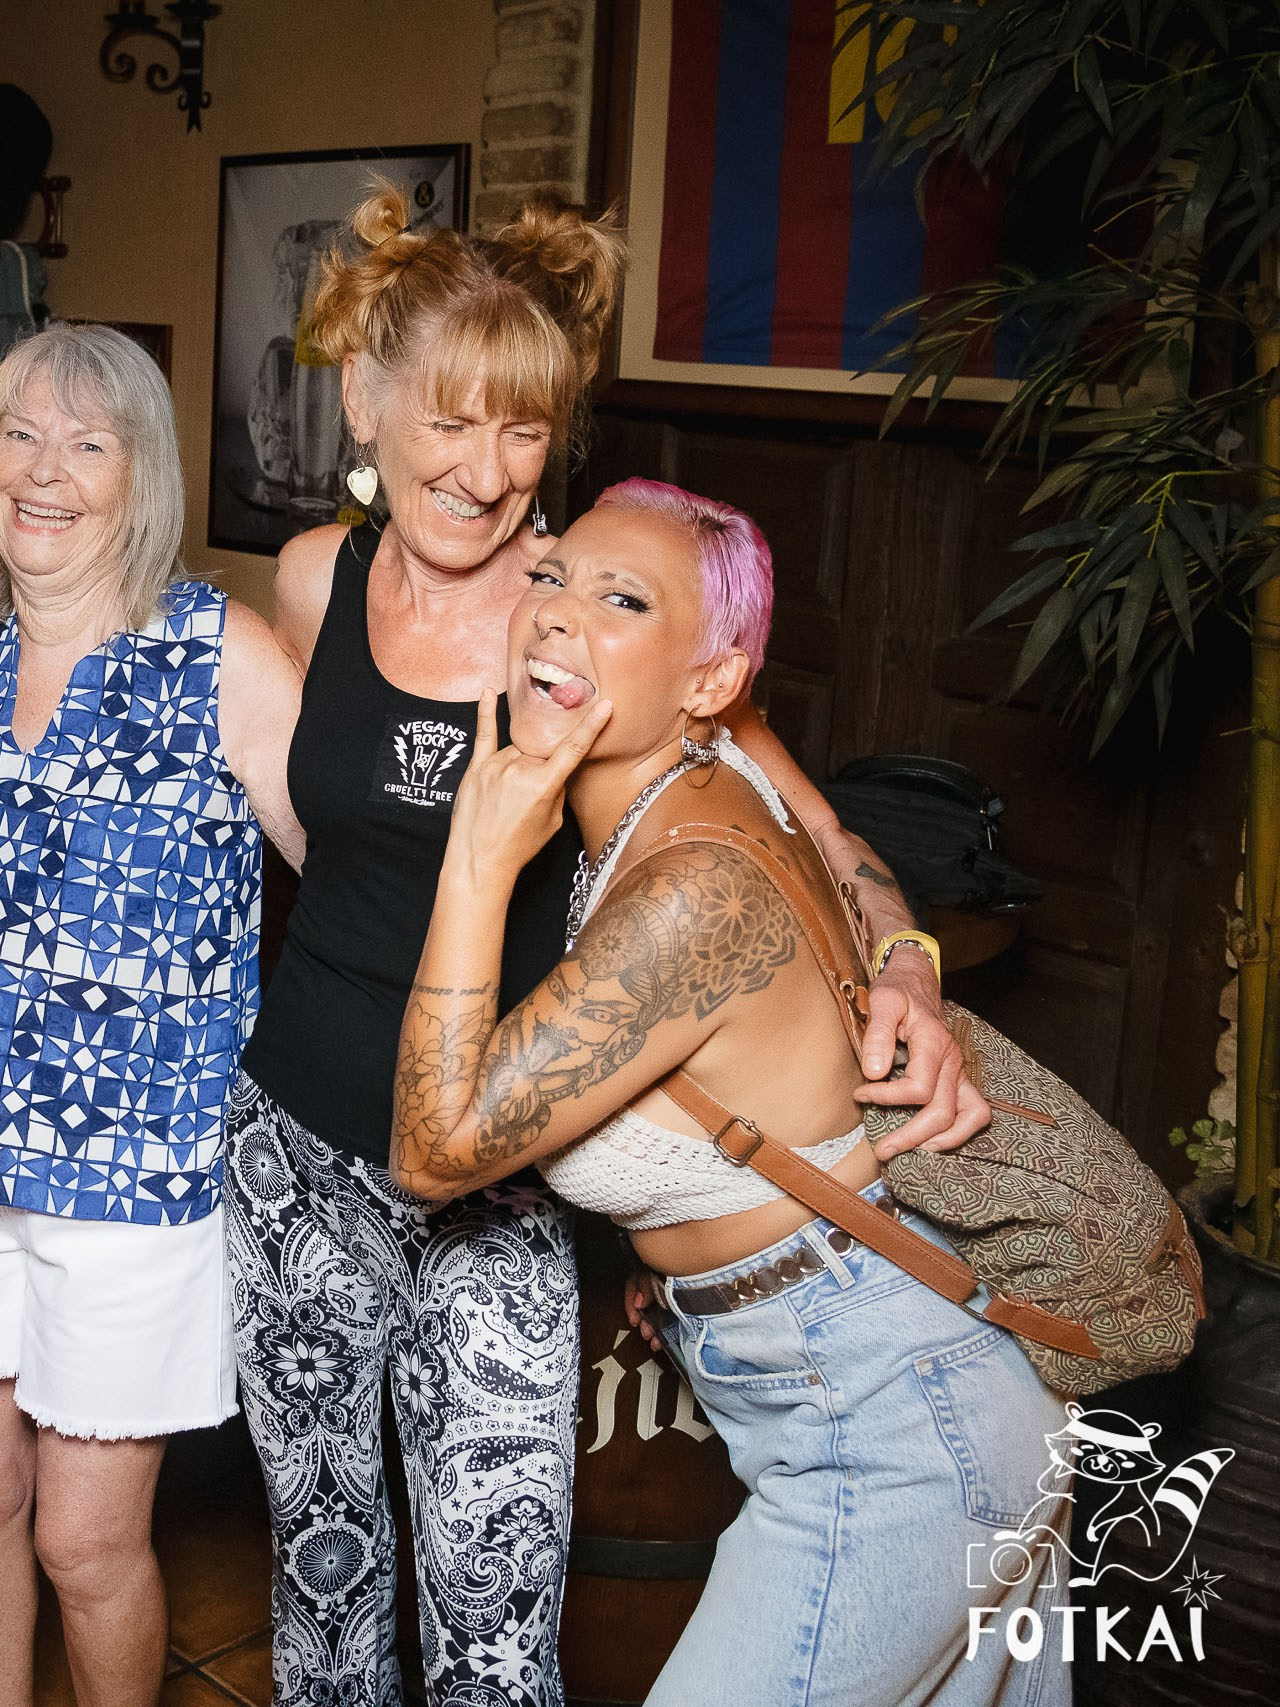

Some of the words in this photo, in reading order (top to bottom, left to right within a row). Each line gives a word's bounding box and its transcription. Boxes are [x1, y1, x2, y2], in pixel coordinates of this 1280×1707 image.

[398, 720, 468, 742] VEGANS
[412, 733, 450, 749] ROCK
[383, 782, 428, 798] CRUELTY
[429, 789, 454, 802] FREE
